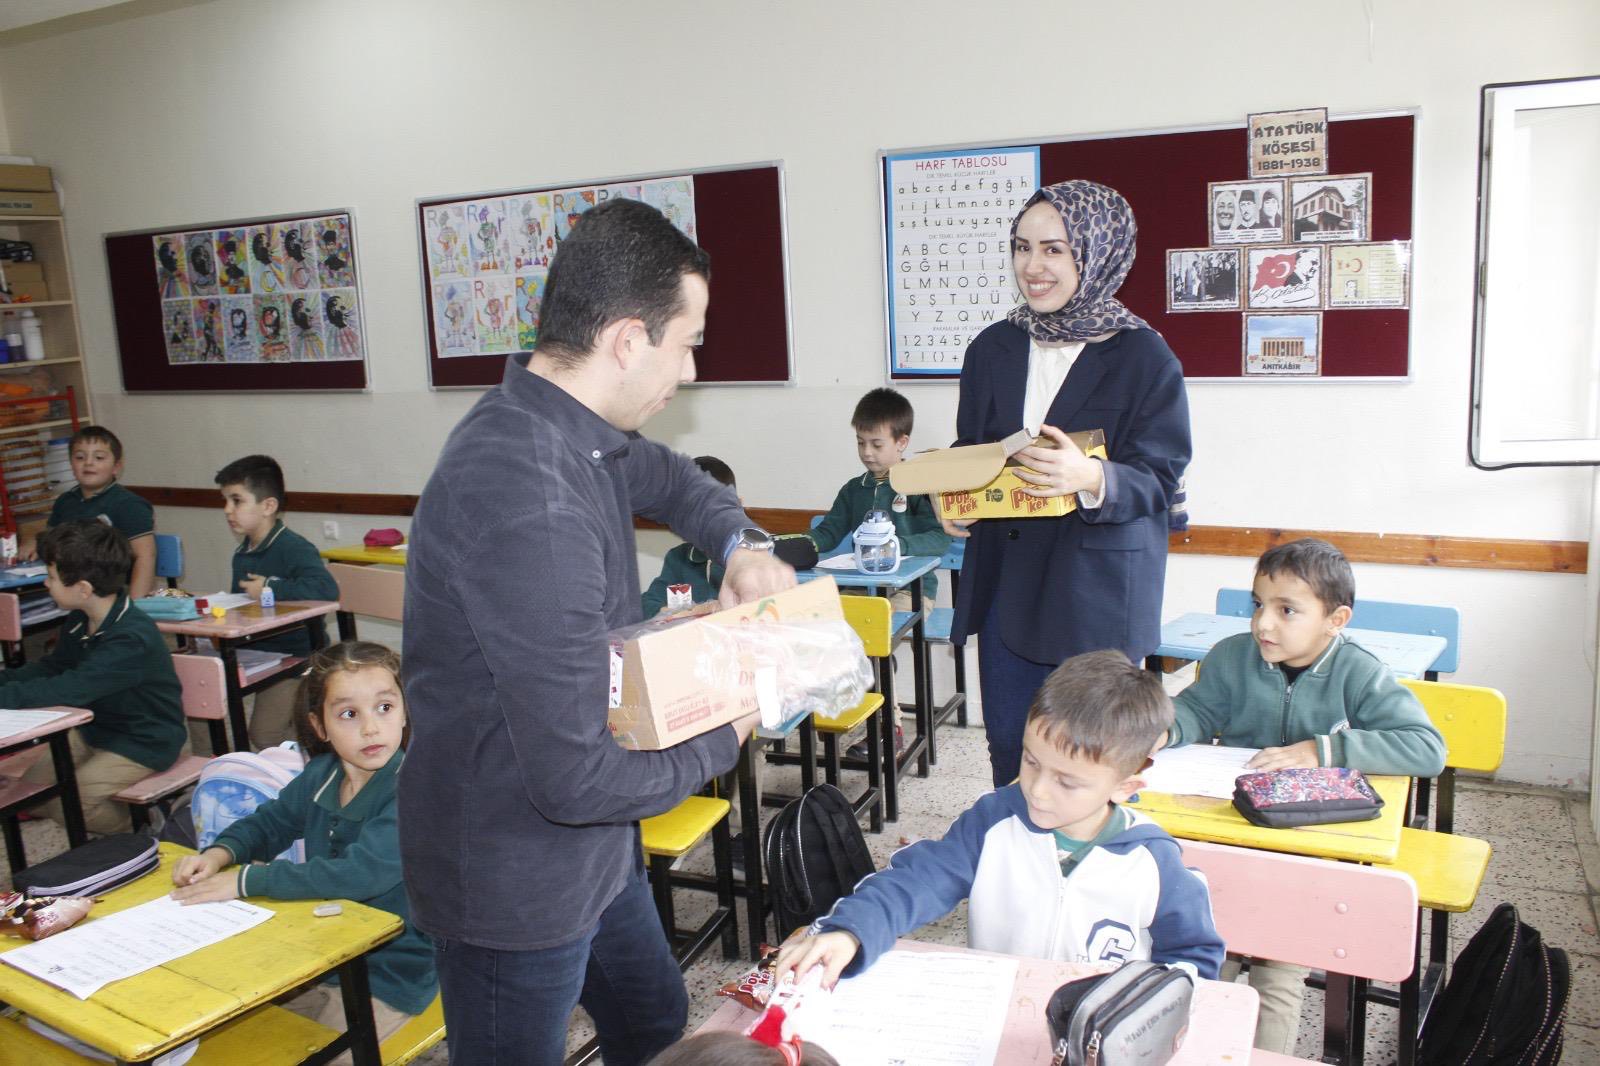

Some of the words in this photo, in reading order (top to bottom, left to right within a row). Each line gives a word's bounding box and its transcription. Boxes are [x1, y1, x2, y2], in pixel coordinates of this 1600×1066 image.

[1254, 121, 1323, 138] ATATÜRK
[1262, 138, 1315, 155] KÖŞESİ
[916, 159, 946, 171] HARF
[952, 156, 1007, 169] TABLOSU
[1258, 158, 1320, 170] 1881-1938
[913, 182, 917, 193] b
[951, 180, 956, 191] d
[979, 178, 984, 189] f
[992, 182, 998, 193] g
[1006, 180, 1012, 192] ğ
[1021, 177, 1027, 187] h
[935, 199, 940, 208] k
[1009, 199, 1014, 209] p
[924, 217, 928, 226] t
[947, 217, 953, 225] ü
[971, 218, 977, 229] y
[996, 217, 1002, 227] q
[902, 245, 910, 255] A
[922, 244, 928, 255] B
[939, 243, 948, 254] C
[979, 242, 987, 253] D
[999, 241, 1005, 252] E
[901, 262, 911, 272] G
[920, 258, 930, 271] Ğ
[939, 261, 948, 271] H
[999, 259, 1004, 269] J
[904, 279, 910, 289] L
[920, 278, 931, 288] M
[940, 278, 948, 288] N
[958, 277, 968, 287] O
[977, 273, 988, 287] Ö
[1000, 276, 1005, 287] P
[910, 295, 916, 305] S
[950, 294, 956, 304] T
[970, 294, 978, 304] U
[991, 290, 999, 304] Ü
[1012, 293, 1020, 303] V
[912, 311, 919, 322] Y
[936, 311, 943, 321] Z
[958, 311, 968, 321] Q
[981, 310, 994, 321] W
[904, 336, 907, 345] 1
[914, 336, 921, 346] 2
[928, 336, 934, 346] 3
[940, 336, 947, 345] 4
[954, 336, 960, 345] 5
